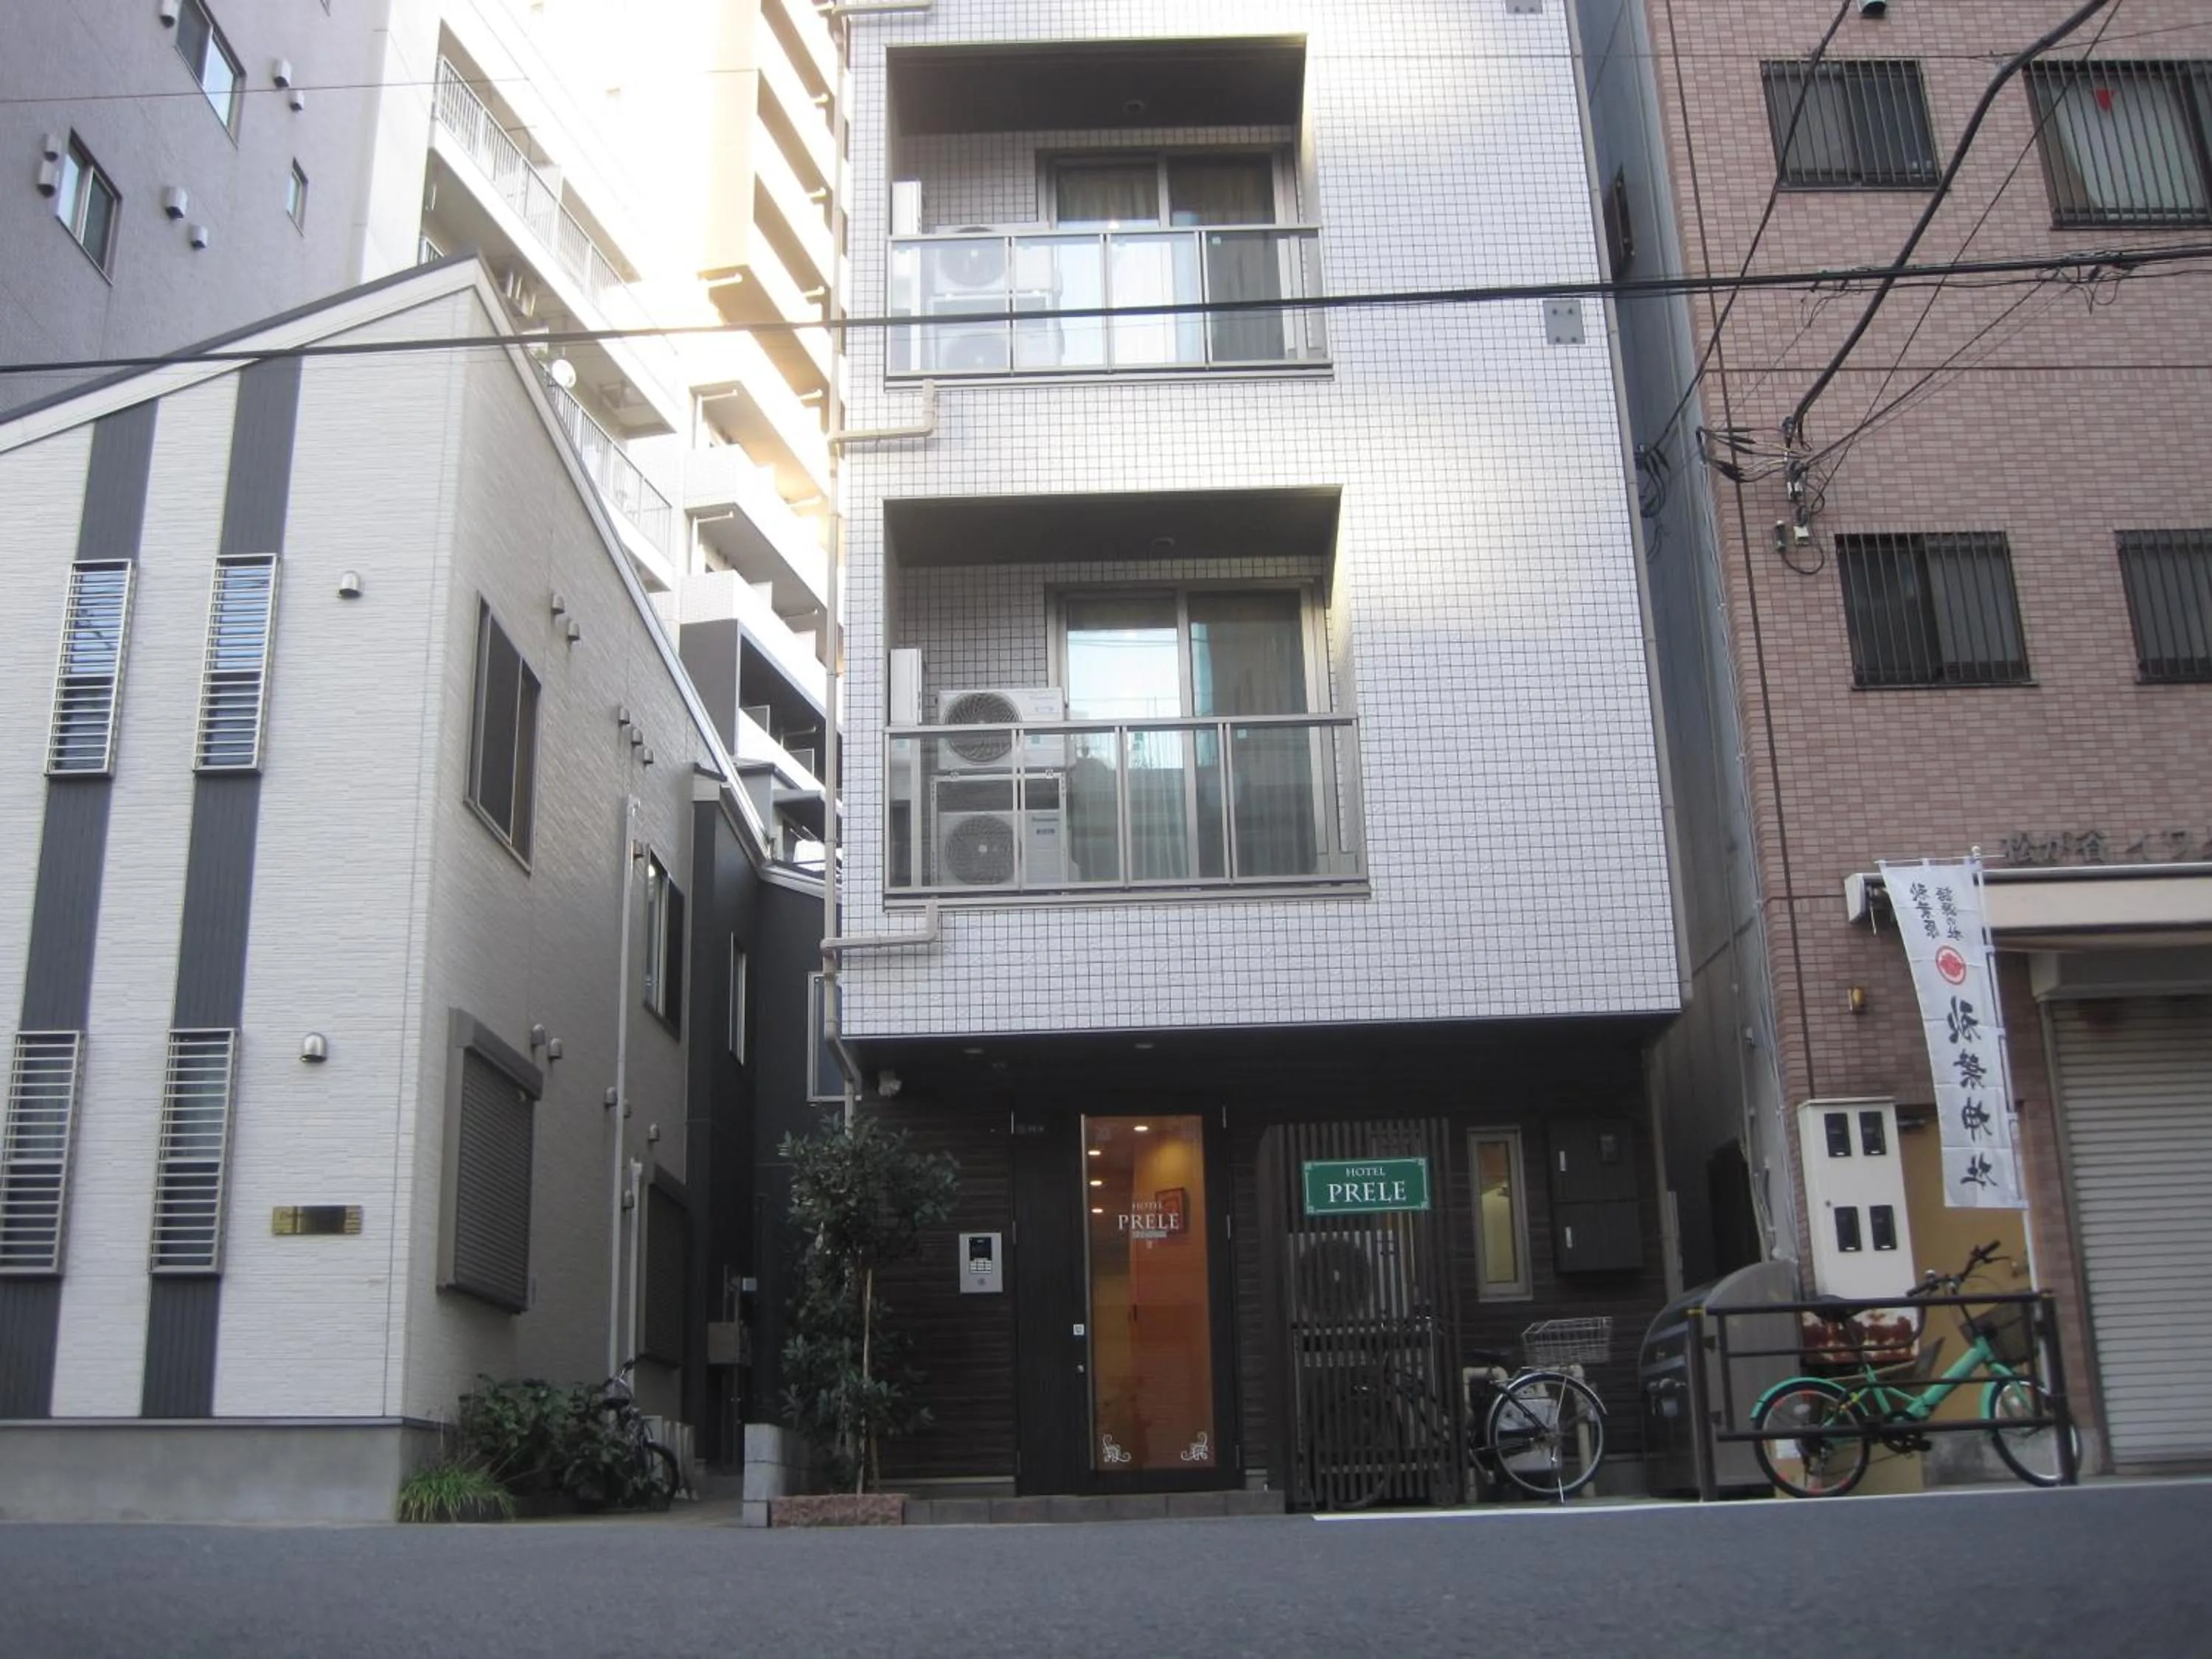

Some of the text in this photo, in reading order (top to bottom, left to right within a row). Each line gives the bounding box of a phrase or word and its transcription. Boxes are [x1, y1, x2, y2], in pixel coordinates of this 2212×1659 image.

[1346, 1167, 1385, 1177] HOTEL
[1328, 1180, 1407, 1203] PRELE
[1118, 1213, 1180, 1230] PRELE
